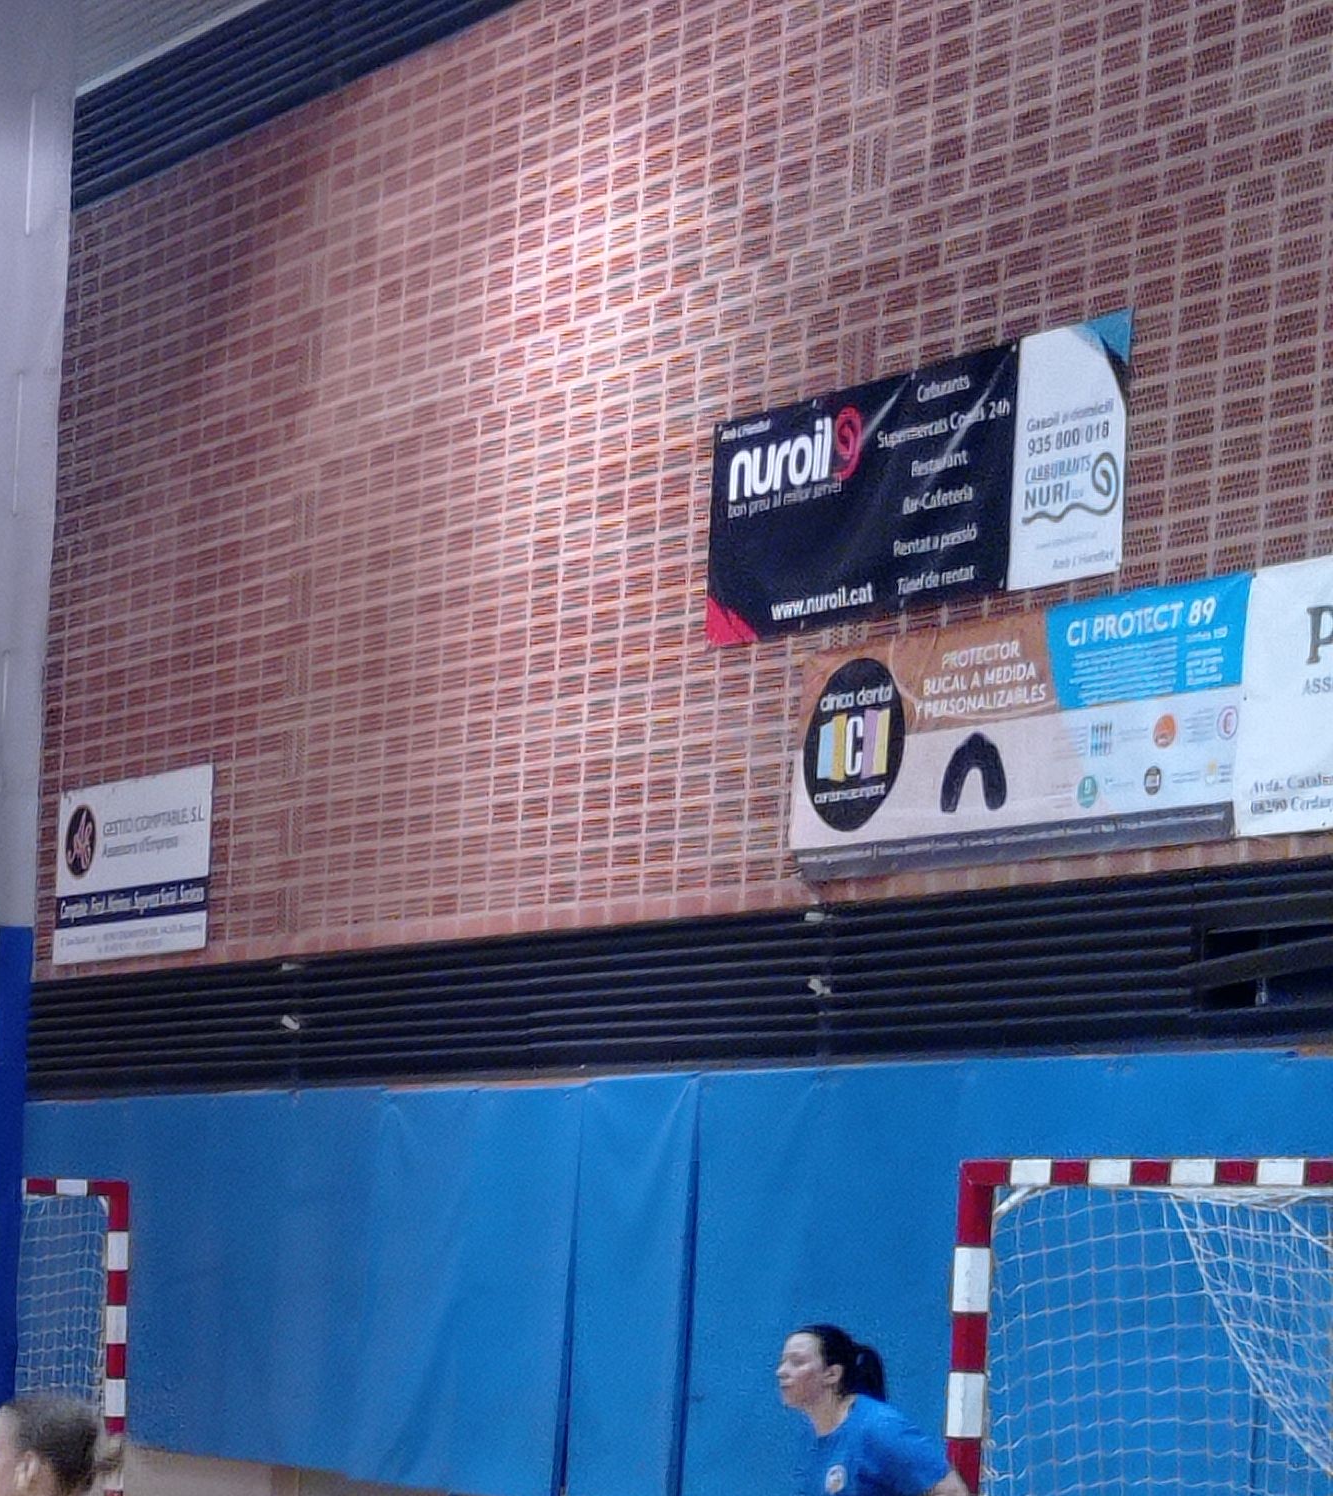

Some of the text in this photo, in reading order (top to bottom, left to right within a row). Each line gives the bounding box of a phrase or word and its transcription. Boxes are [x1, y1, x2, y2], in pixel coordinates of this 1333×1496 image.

[989, 398, 1010, 419] 24h
[729, 416, 832, 502] nuroil
[1027, 435, 1051, 457] 935
[1024, 481, 1070, 511] NURI
[771, 582, 873, 621] www.nuroil.cat
[1091, 601, 1184, 642] PROTECT
[941, 639, 1021, 670] PROTECTOR
[923, 662, 1036, 697] BUCAL A MEDIDA
